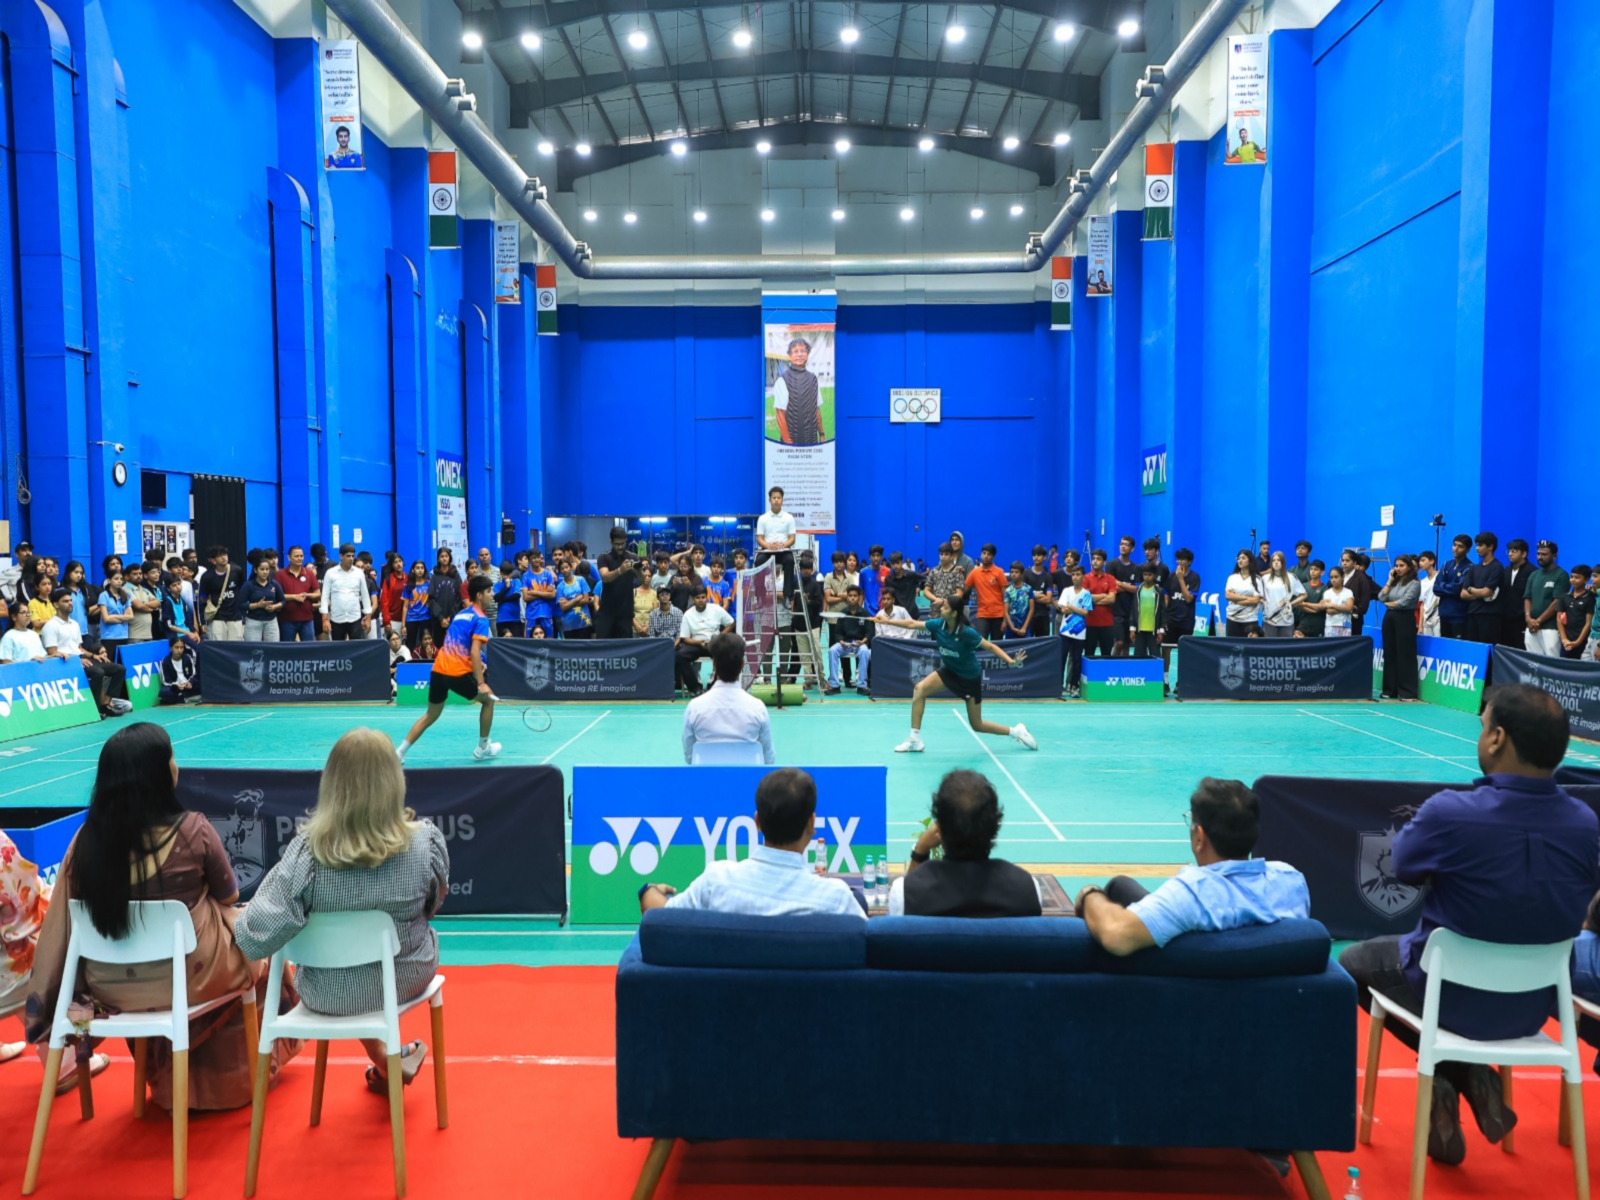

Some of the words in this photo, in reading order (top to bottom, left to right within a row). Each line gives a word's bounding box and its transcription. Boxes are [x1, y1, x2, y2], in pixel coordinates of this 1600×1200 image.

[436, 459, 461, 489] YONEX
[269, 660, 353, 672] PROMETHEUS
[554, 657, 637, 669] PROMETHEUS
[1249, 656, 1336, 669] PROMETHEUS
[269, 672, 320, 684] SCHOOL
[554, 670, 604, 681] SCHOOL
[1250, 669, 1301, 681] SCHOOL
[1436, 658, 1478, 691] YONEX
[1121, 676, 1145, 686] YONEX
[269, 686, 301, 695] learning
[303, 686, 314, 694] RE
[316, 686, 352, 695] imagined
[554, 684, 586, 693] learning
[600, 684, 637, 693] imagined
[986, 684, 1023, 692] imagined
[1249, 684, 1282, 693] learning
[1284, 684, 1296, 692] RE
[1297, 684, 1335, 693] imagined
[1542, 676, 1600, 702] PROMETHE
[17, 677, 86, 712] YONEX
[693, 815, 860, 873] YOEX
